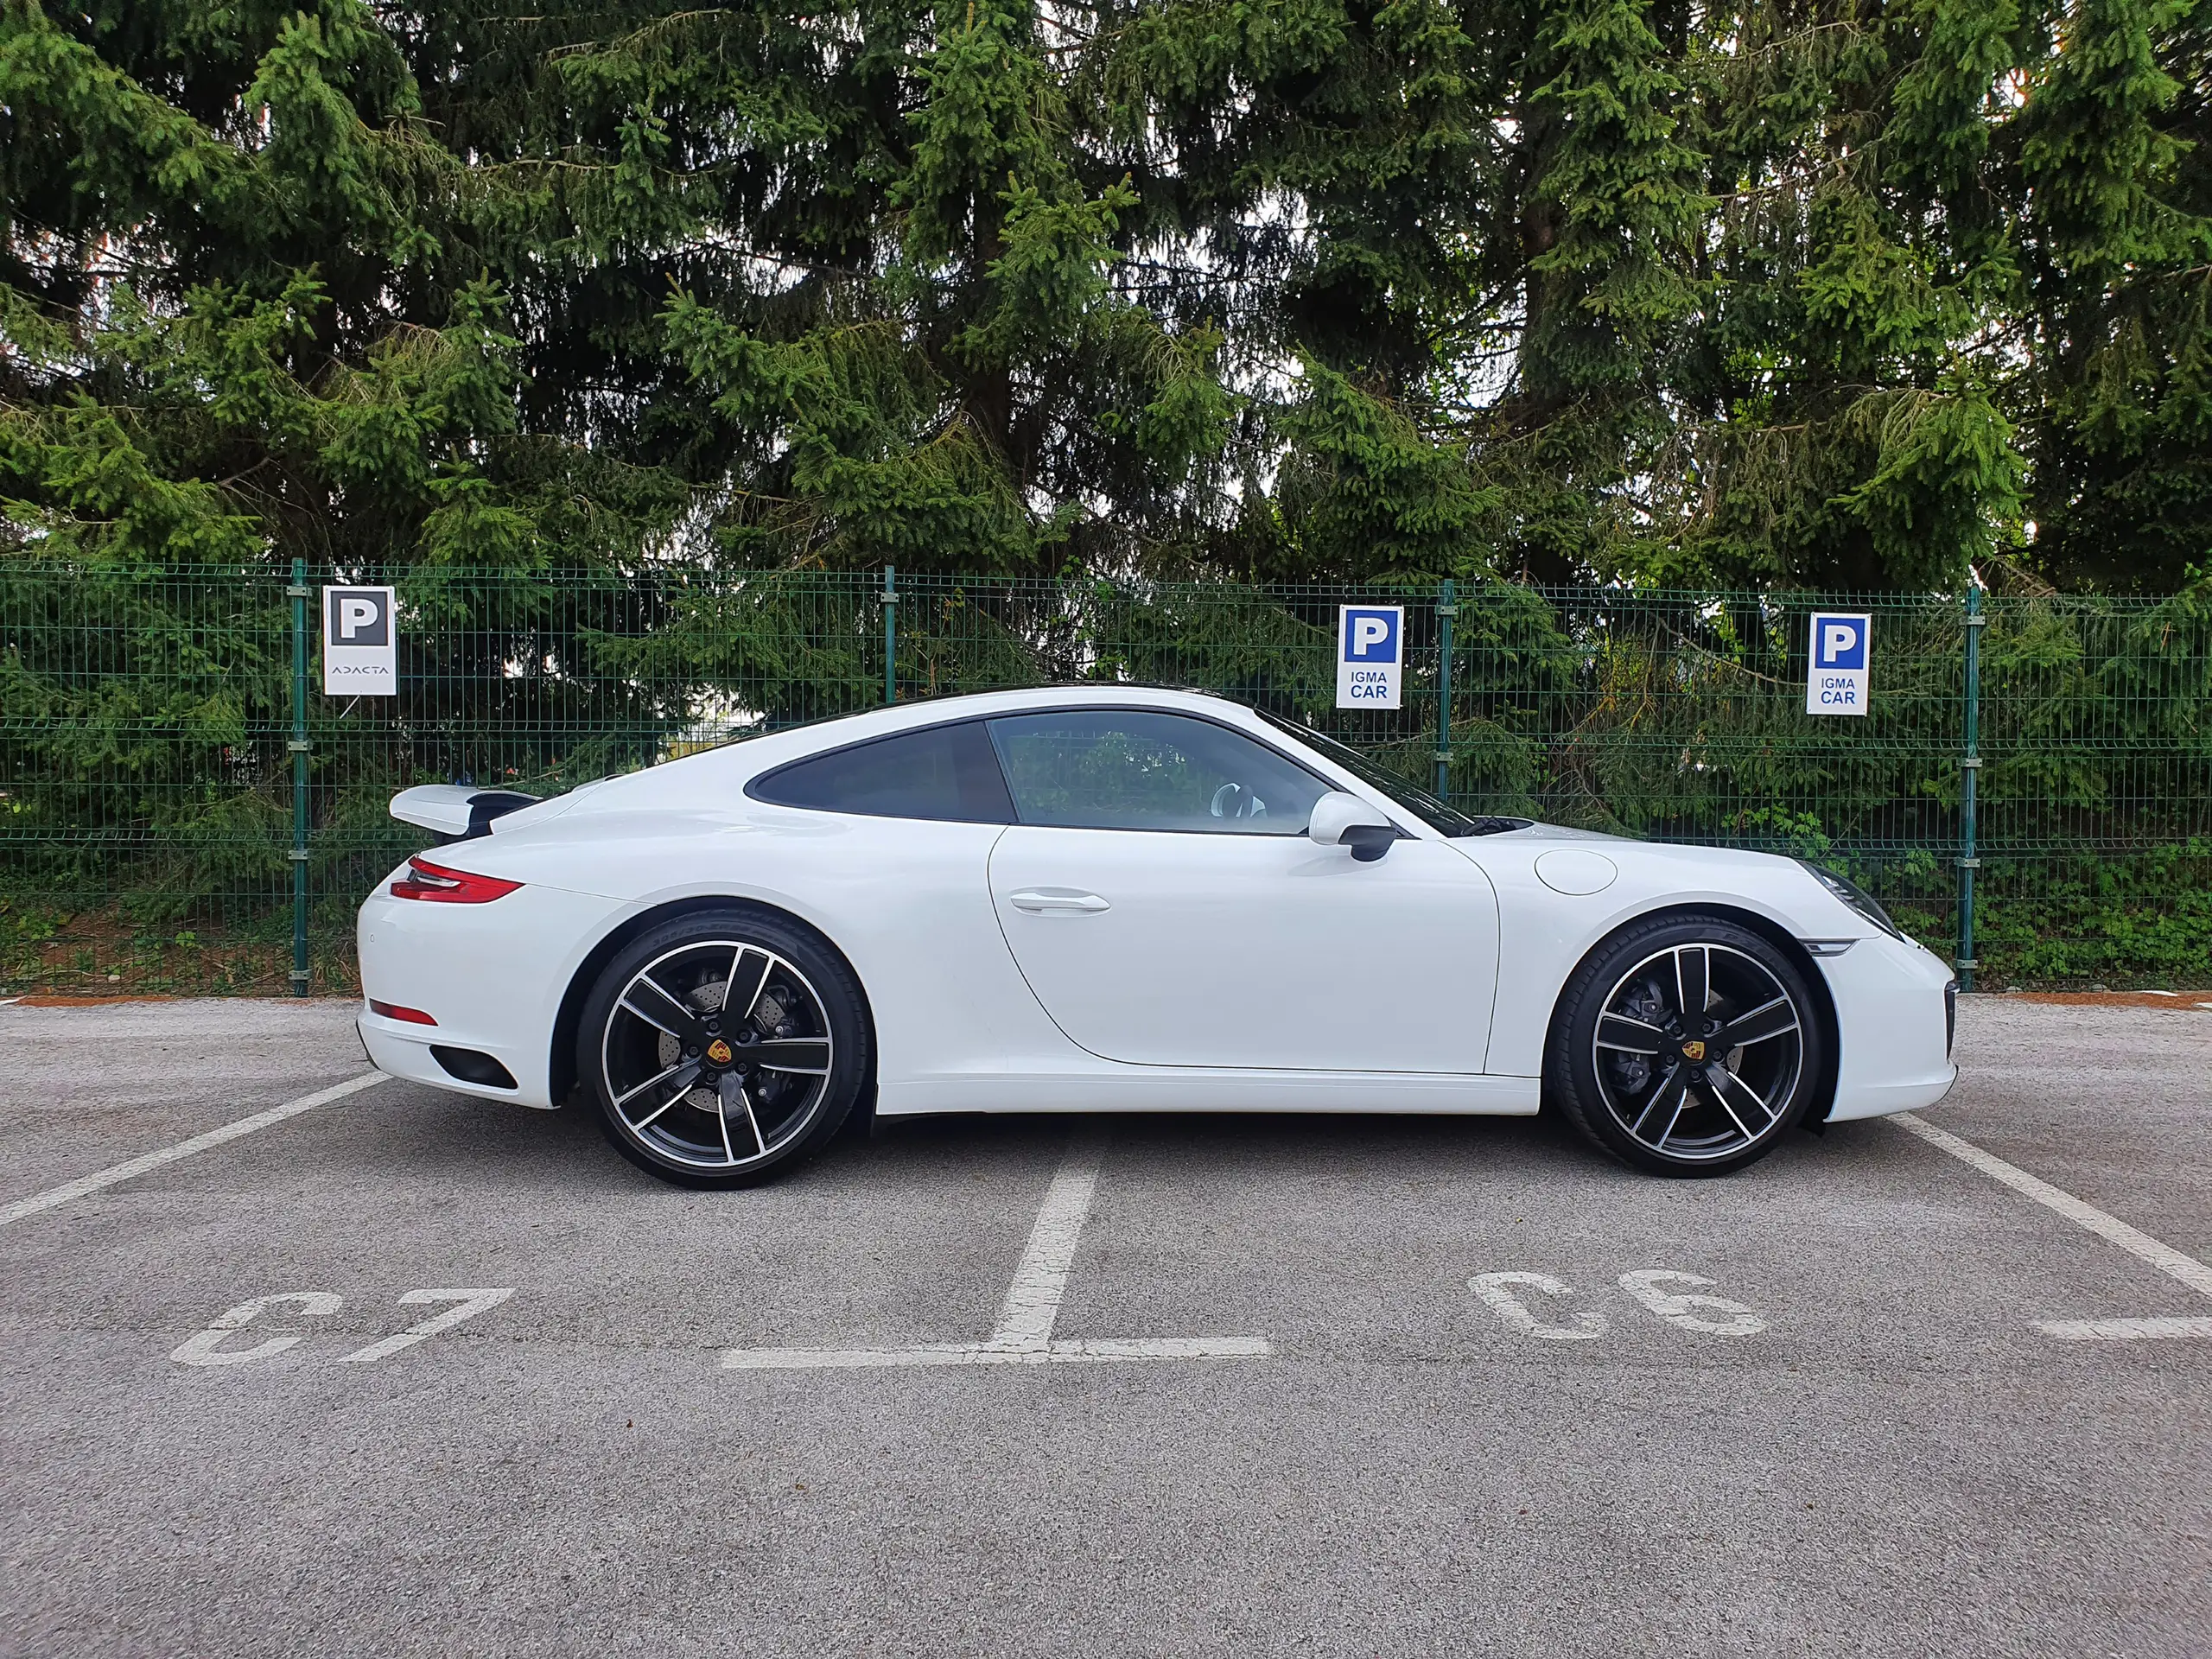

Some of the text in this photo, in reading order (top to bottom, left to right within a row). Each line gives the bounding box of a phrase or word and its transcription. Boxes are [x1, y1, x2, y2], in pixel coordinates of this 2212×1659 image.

[340, 598, 378, 639] P
[1353, 617, 1389, 656] P
[1823, 625, 1857, 663] P
[1351, 671, 1387, 683] IGMA
[1351, 685, 1388, 698] CAR
[1821, 677, 1855, 689] IGMA
[1821, 691, 1855, 704] CAR
[1469, 1268, 1769, 1339] C6
[170, 1287, 517, 1366] C7
